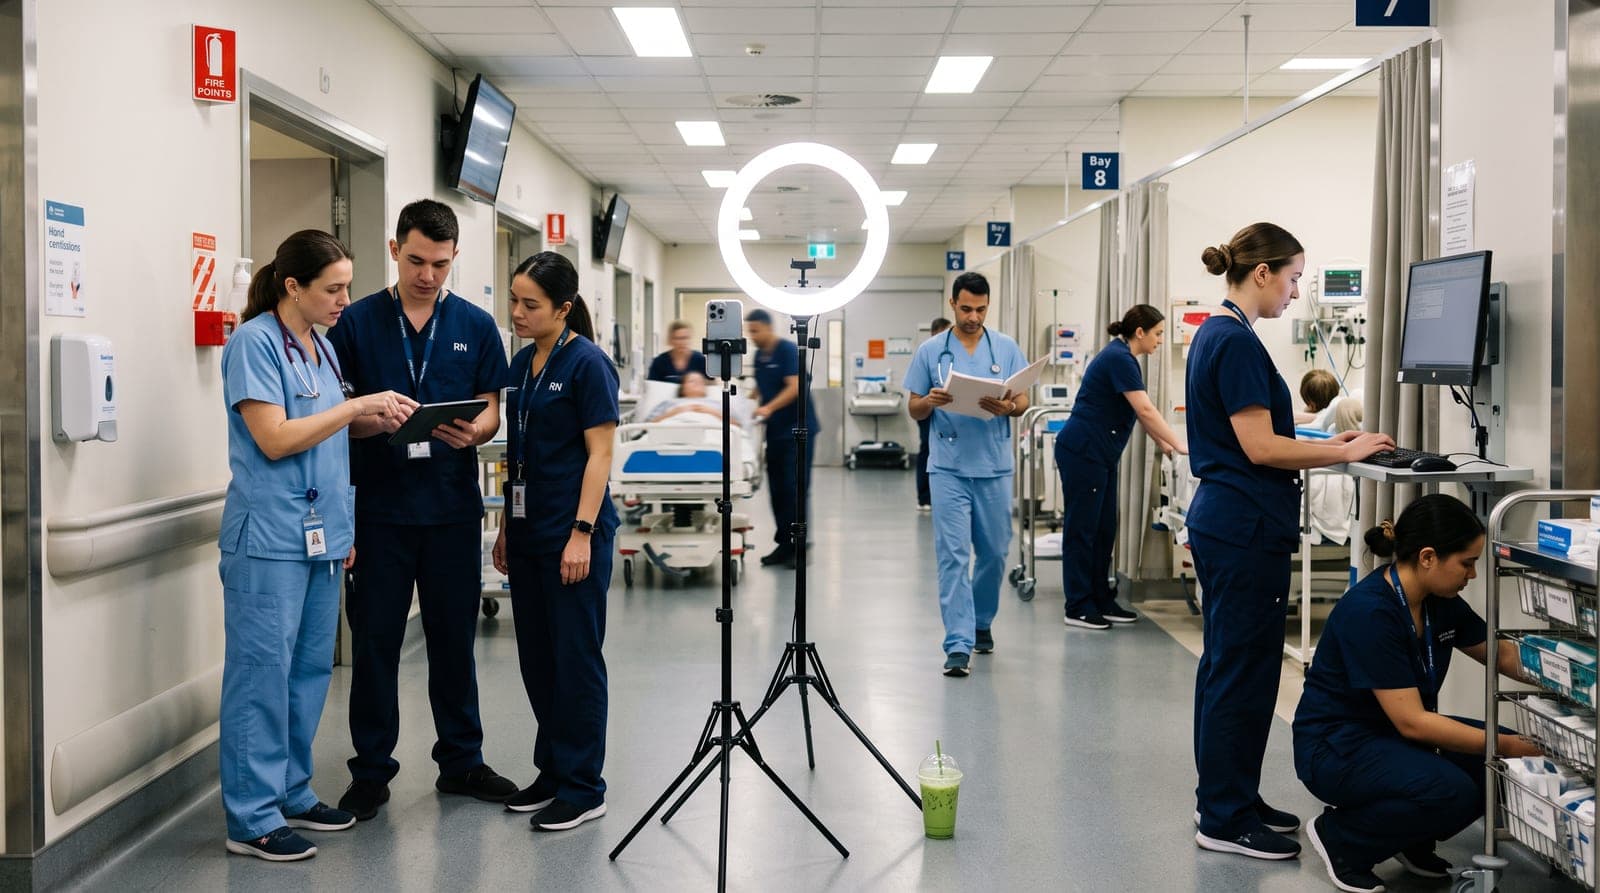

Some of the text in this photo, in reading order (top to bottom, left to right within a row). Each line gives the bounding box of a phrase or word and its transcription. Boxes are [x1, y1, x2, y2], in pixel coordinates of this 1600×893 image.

[204, 78, 225, 88] FIRE
[197, 87, 232, 98] POINTS
[1090, 155, 1111, 169] Bay
[1094, 169, 1106, 187] 8
[991, 224, 1006, 233] Bay
[994, 233, 1002, 245] 7
[951, 260, 960, 270] 6
[453, 342, 468, 353] RN
[548, 382, 563, 392] RN
